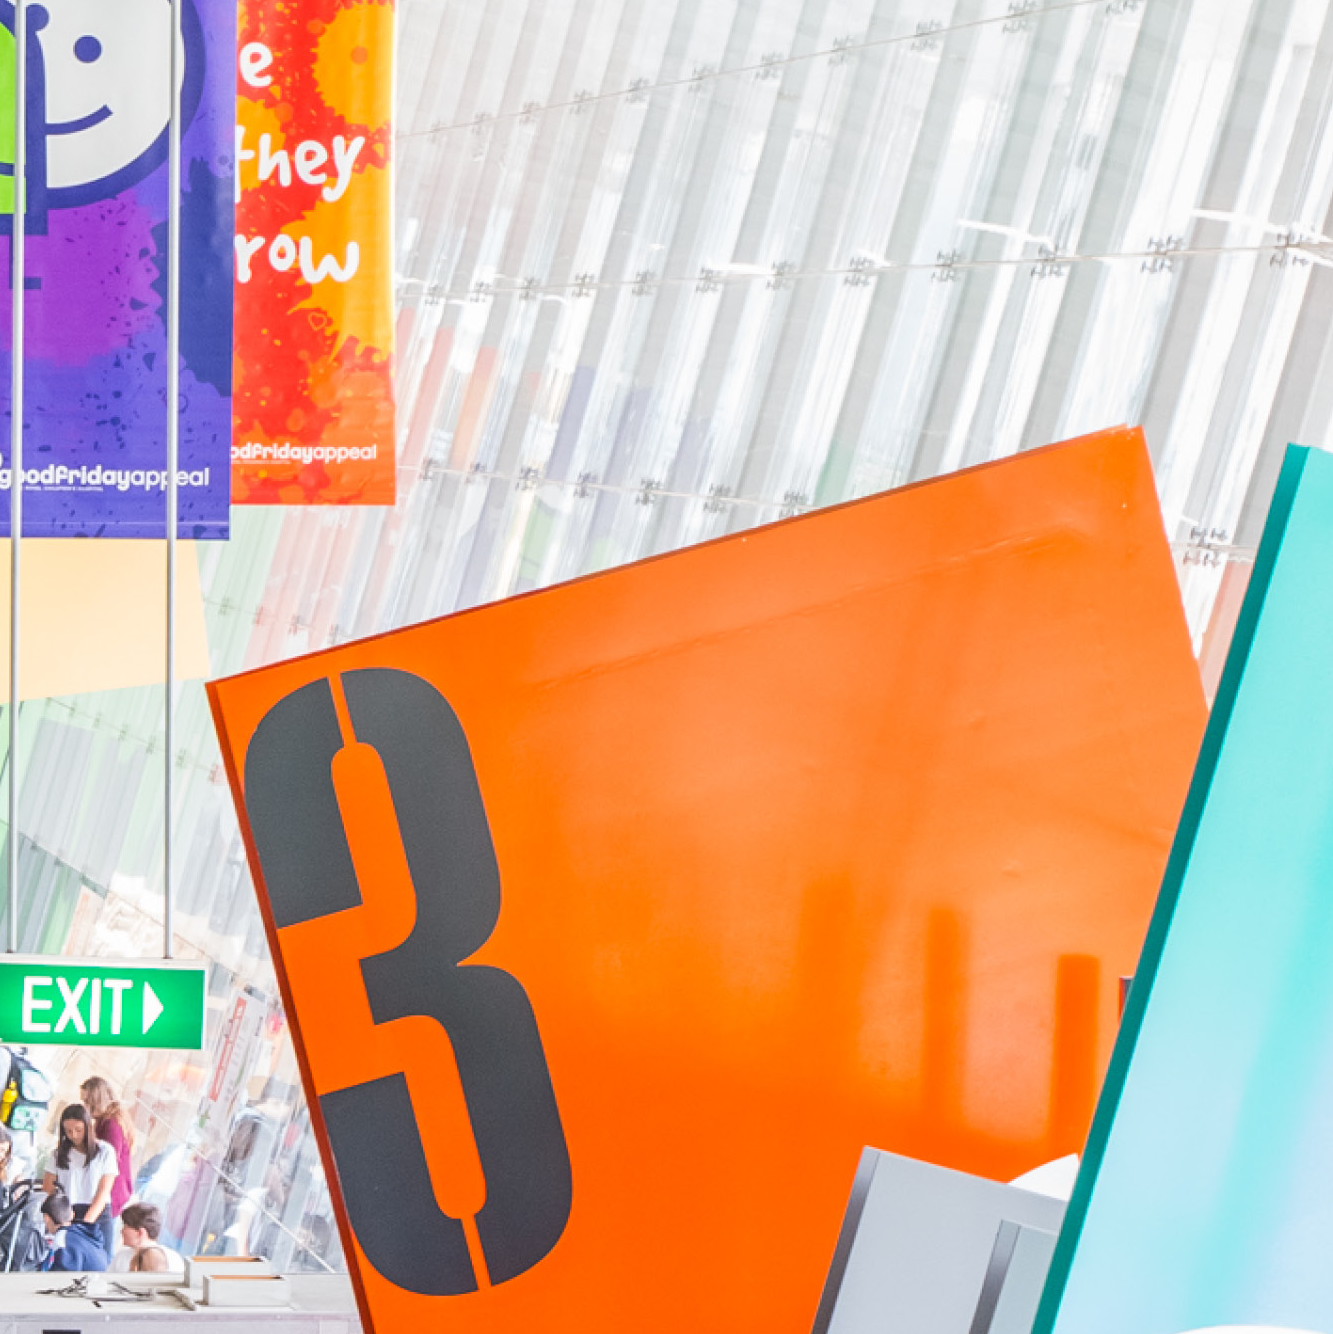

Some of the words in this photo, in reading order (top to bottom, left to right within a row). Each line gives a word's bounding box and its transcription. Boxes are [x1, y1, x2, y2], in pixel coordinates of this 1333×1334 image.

[233, 233, 361, 284] row
[21, 975, 132, 1036] EXIT
[243, 667, 574, 1297] 3
